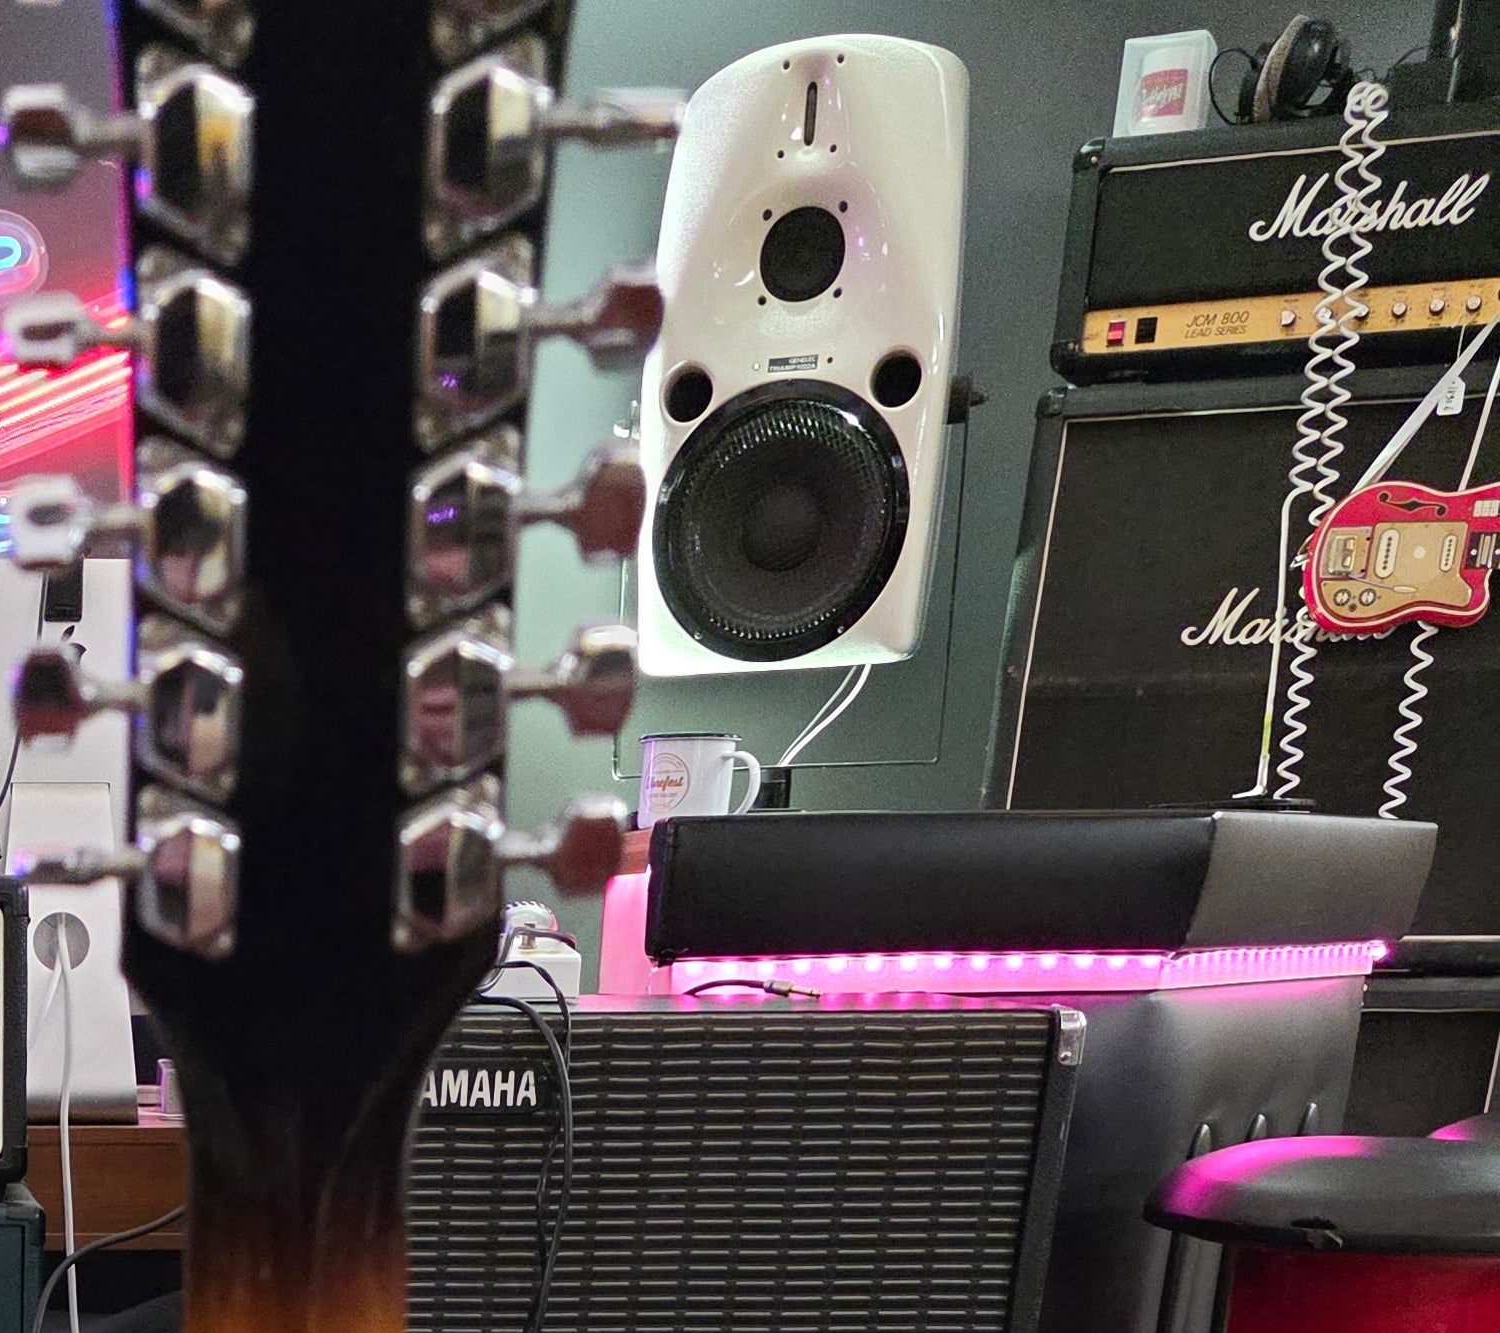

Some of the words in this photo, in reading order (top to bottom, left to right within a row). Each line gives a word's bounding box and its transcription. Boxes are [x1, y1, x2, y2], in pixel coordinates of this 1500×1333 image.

[1249, 172, 1490, 242] Marshall
[1184, 328, 1211, 339] LEAD
[1215, 325, 1248, 337] SERIES
[1186, 313, 1217, 328] JCM
[1221, 311, 1249, 325] 800
[416, 1069, 537, 1107] AMAHA
